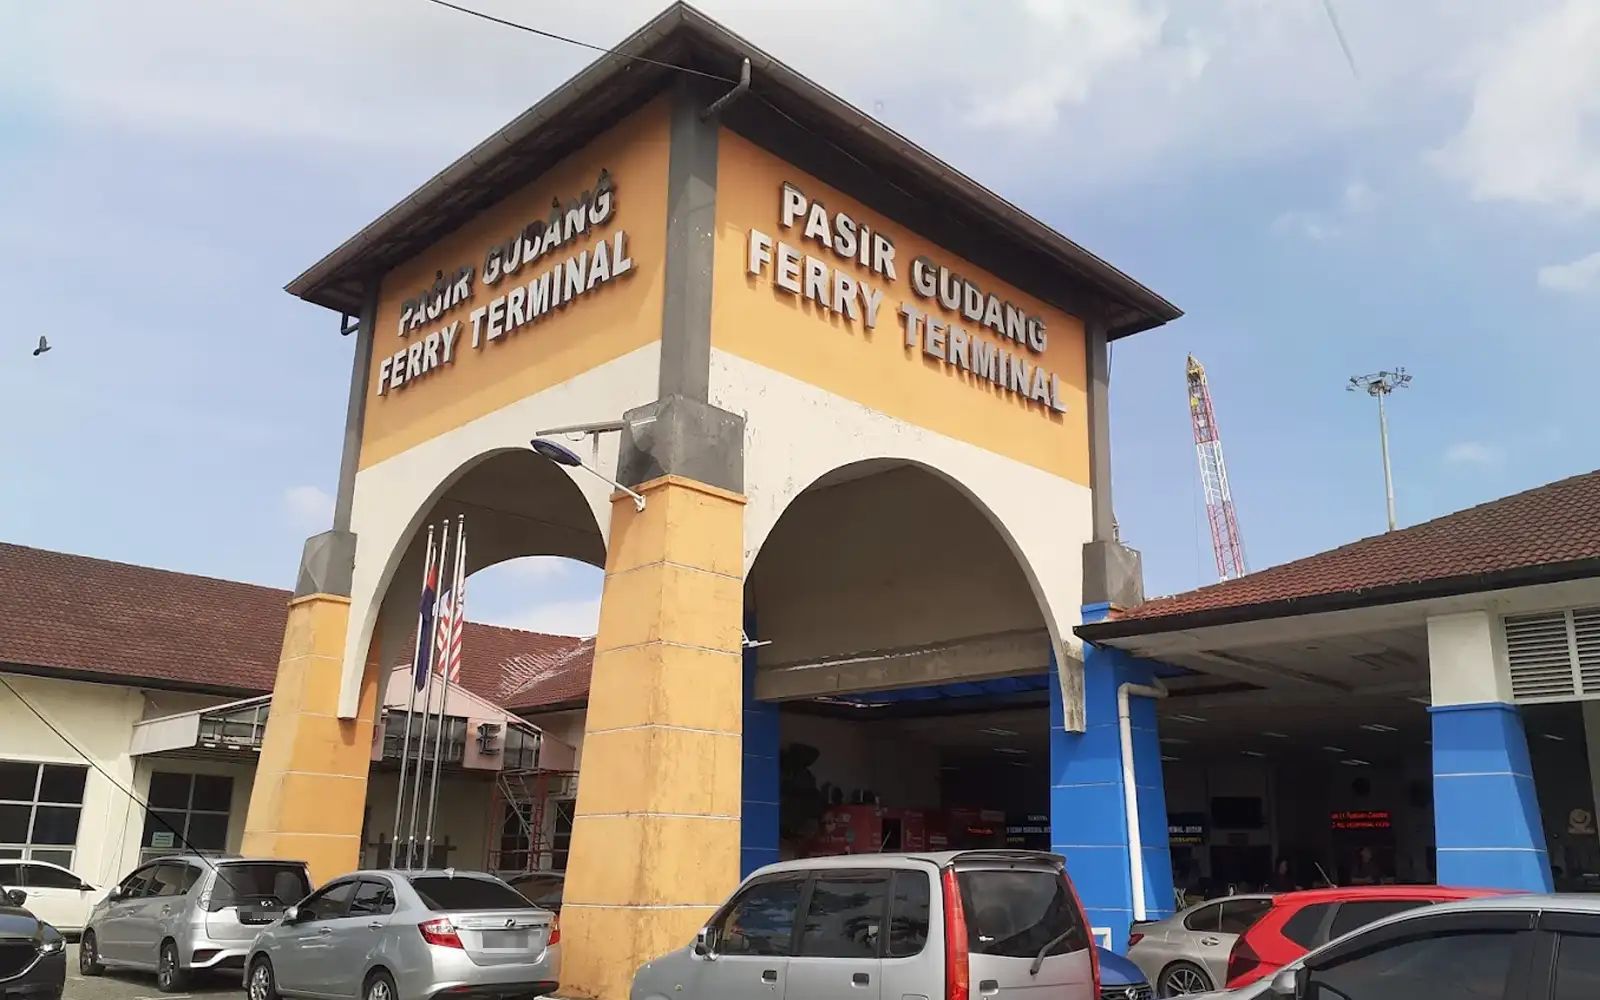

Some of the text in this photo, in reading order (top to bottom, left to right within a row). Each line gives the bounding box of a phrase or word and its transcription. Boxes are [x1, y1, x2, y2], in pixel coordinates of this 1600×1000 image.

[376, 230, 633, 396] FERRY TERMINAL
[397, 178, 615, 337] PASIR GUDANG
[747, 228, 1067, 413] FERRY TERMINAL
[782, 181, 1047, 352] PASIR GUDANG
